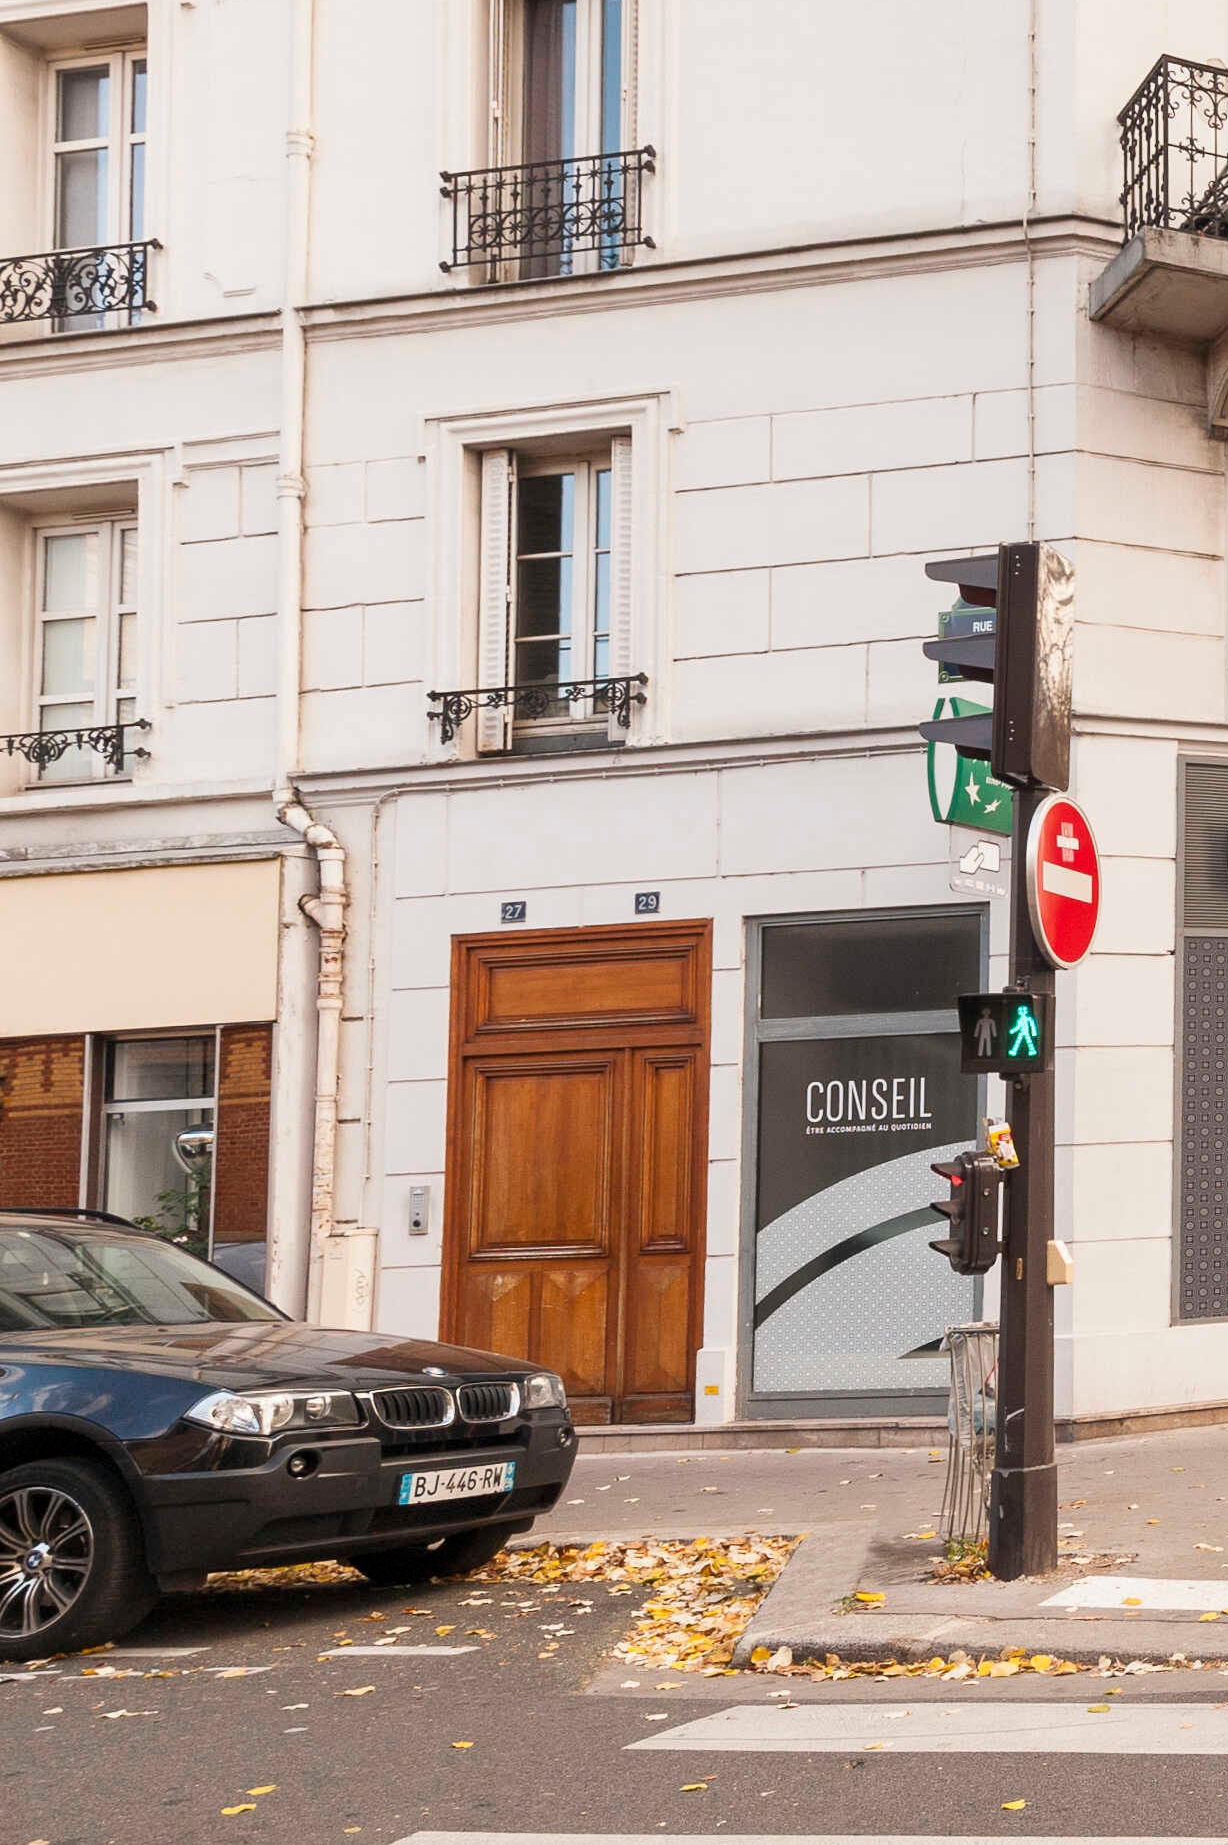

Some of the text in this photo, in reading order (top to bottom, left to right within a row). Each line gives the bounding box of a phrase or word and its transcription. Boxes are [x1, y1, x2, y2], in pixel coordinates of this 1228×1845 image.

[972, 620, 993, 632] RUE
[638, 895, 657, 910] 29
[505, 904, 522, 919] 27
[806, 1077, 932, 1122] CONSEIL
[806, 1122, 932, 1135] ÊTRE ACCOMPAGNÉ AU QUOTIDIEN
[413, 1466, 503, 1498] BJ-446-RW
